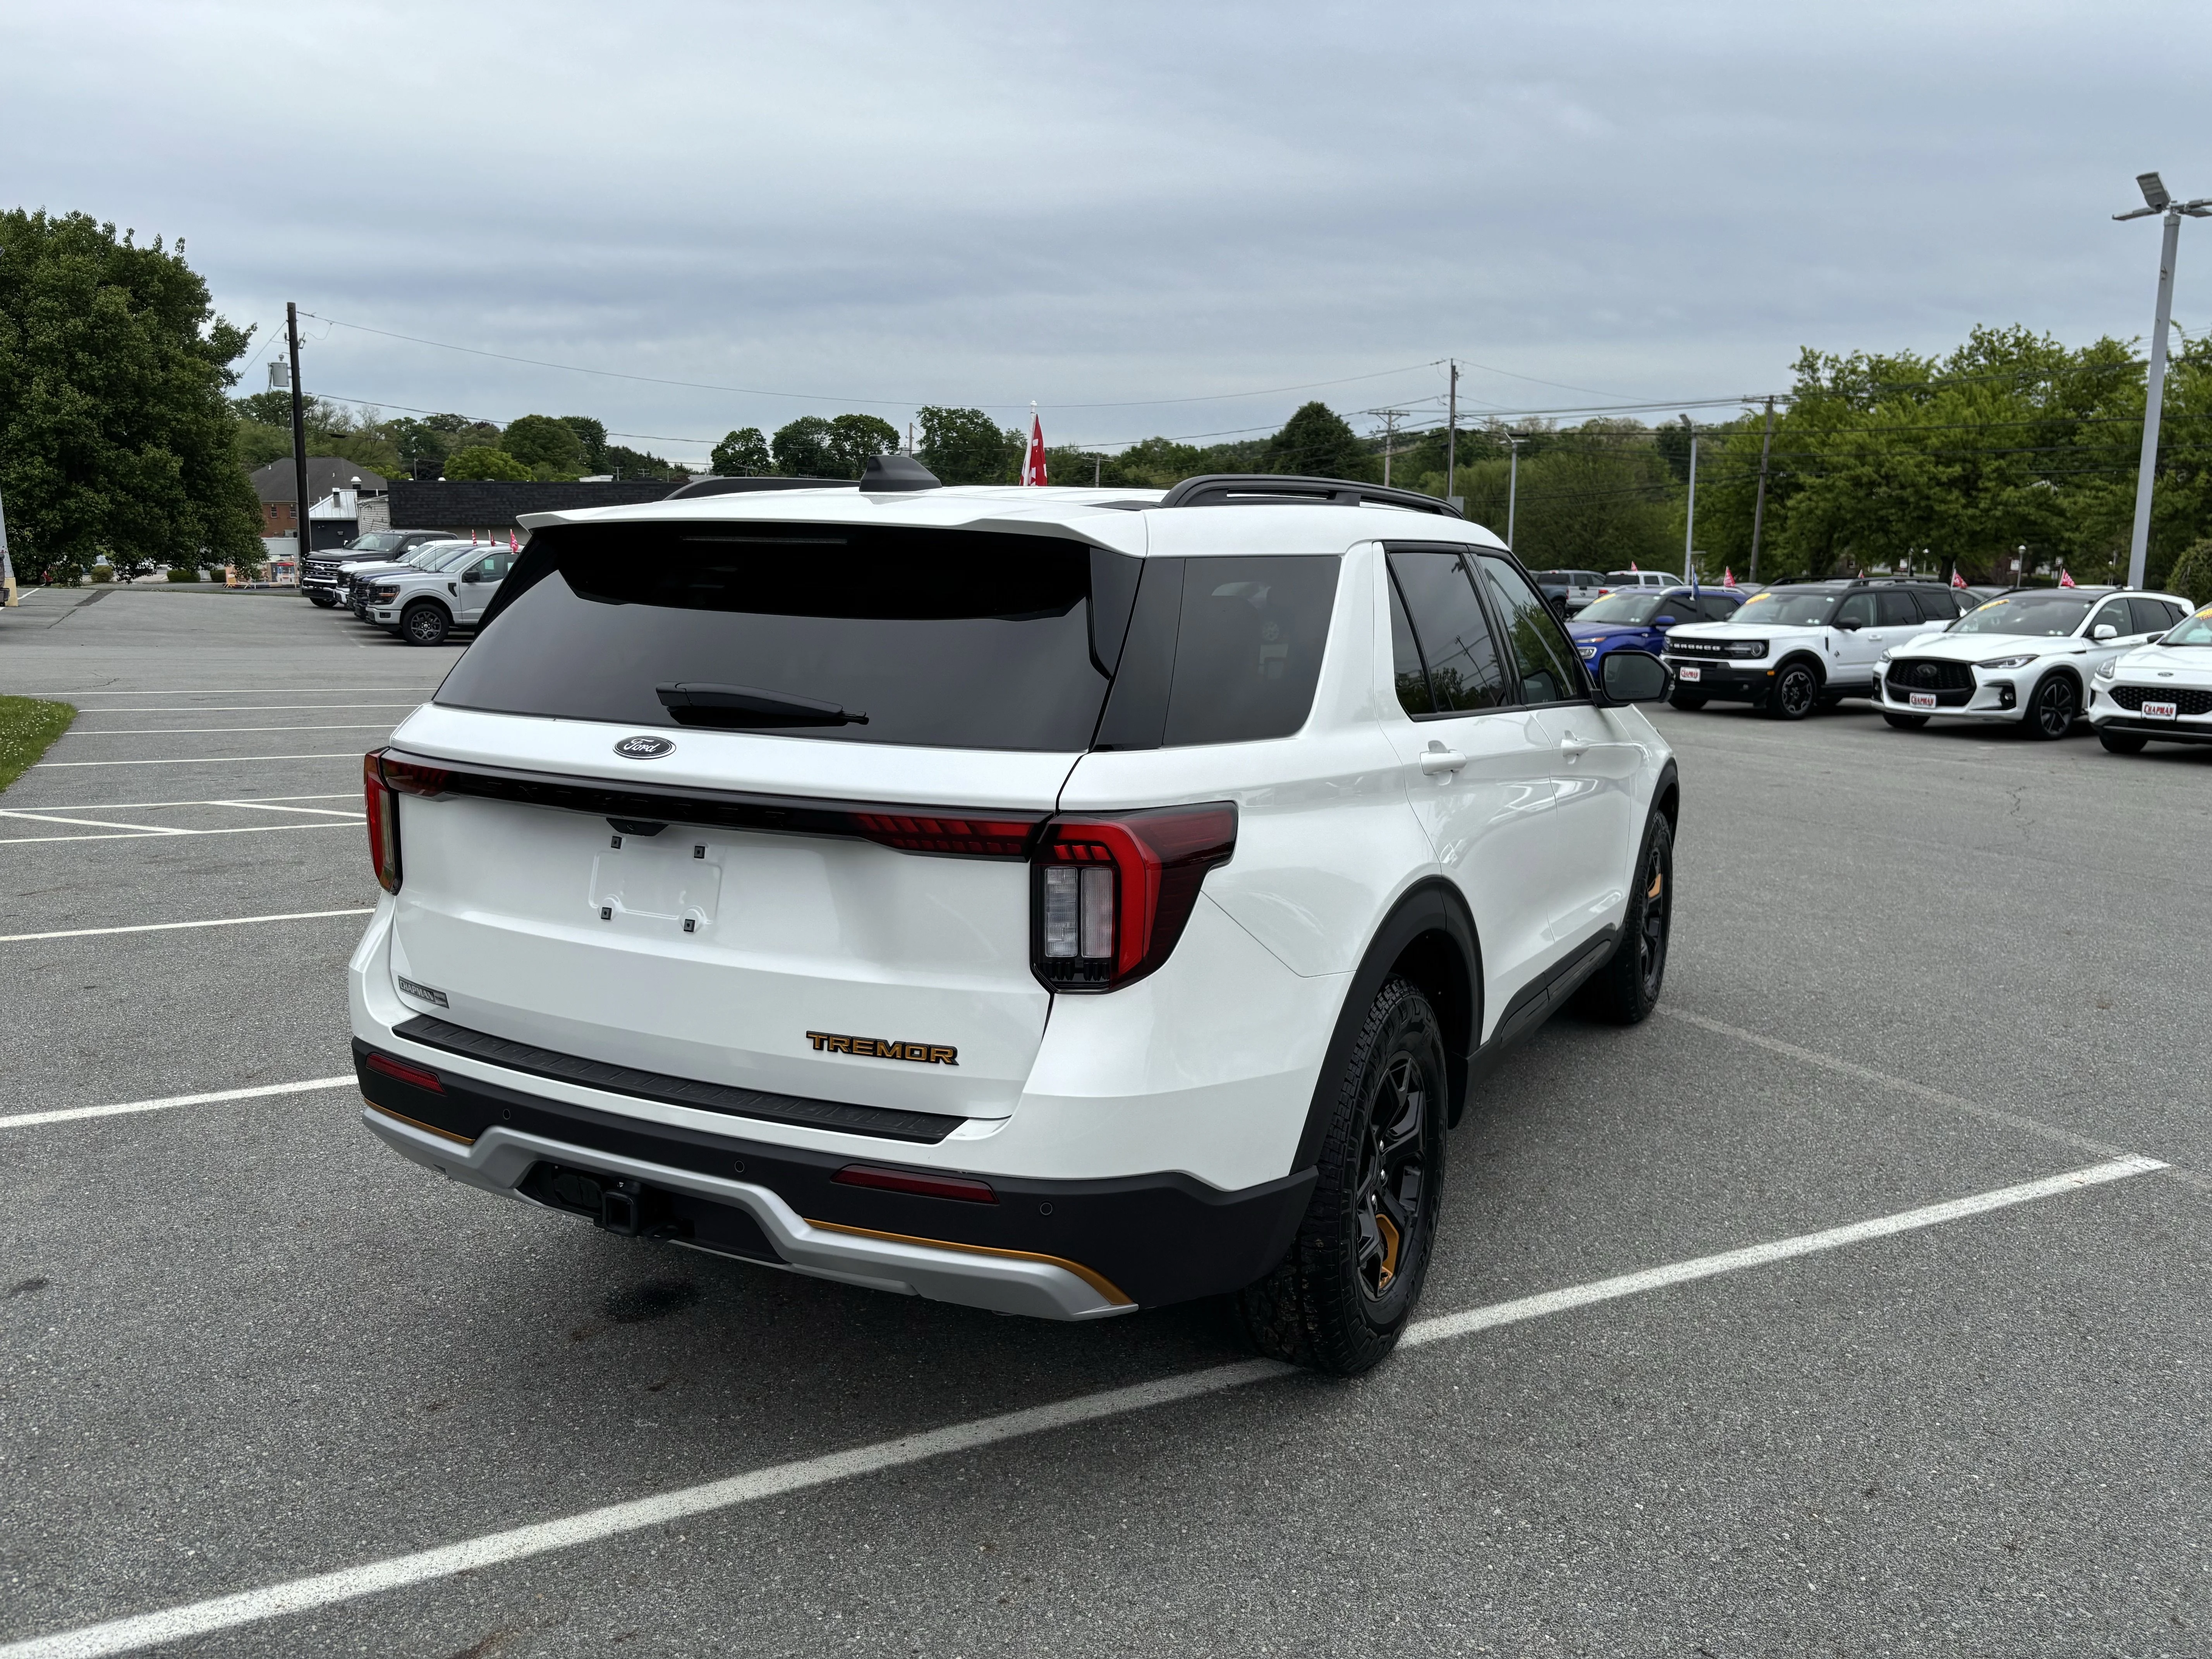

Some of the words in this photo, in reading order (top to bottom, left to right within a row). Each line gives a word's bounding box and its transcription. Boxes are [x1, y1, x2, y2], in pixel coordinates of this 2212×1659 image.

[2144, 704, 2174, 716] CHAPMAN
[623, 738, 661, 752] Ford
[400, 980, 434, 1000] CHAPMAN
[806, 1030, 960, 1066] TREMOR
